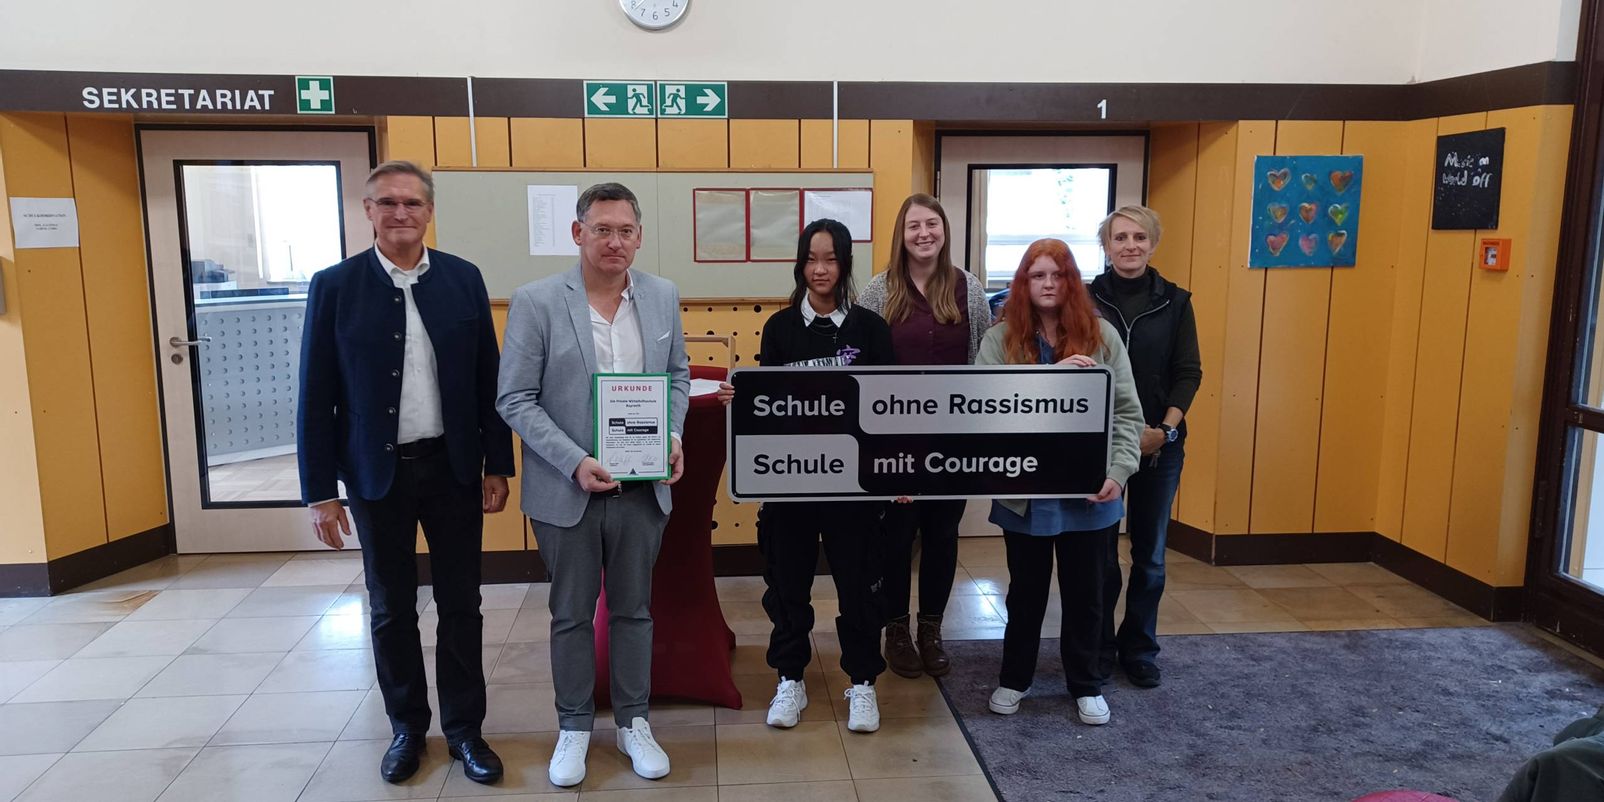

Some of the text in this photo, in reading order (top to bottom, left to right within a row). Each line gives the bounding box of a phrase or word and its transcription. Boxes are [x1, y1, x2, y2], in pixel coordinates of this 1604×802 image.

[640, 8, 646, 17] 7
[652, 11, 659, 20] 6
[664, 7, 671, 17] 5
[81, 86, 275, 110] SEKRETARIAT
[1096, 98, 1107, 119] 1
[1472, 172, 1493, 188] off
[753, 392, 1089, 417] Schule ohne Rassismus
[753, 451, 1039, 478] Schule mit Courage
